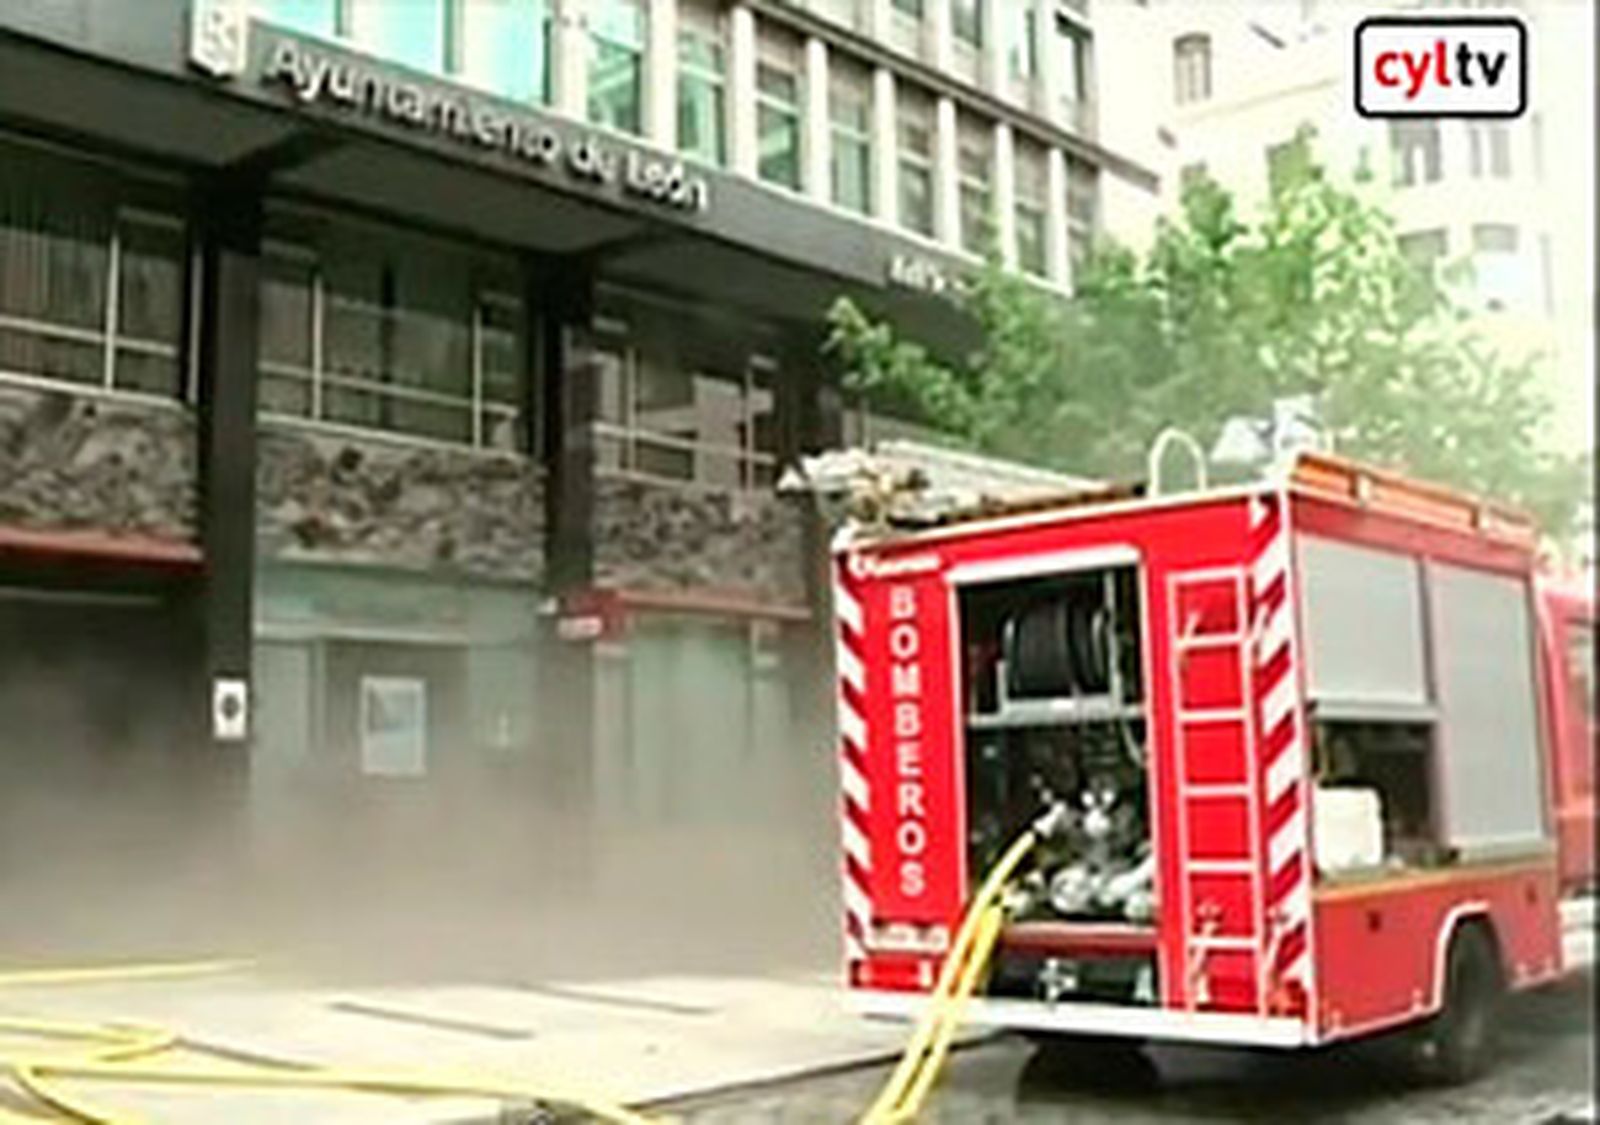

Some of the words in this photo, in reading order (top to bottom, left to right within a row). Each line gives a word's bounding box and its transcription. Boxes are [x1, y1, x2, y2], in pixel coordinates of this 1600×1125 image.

[267, 42, 562, 163] Ayuntamiento
[569, 135, 613, 183] de
[626, 152, 709, 209] León
[889, 585, 926, 896] BOMBEROS
